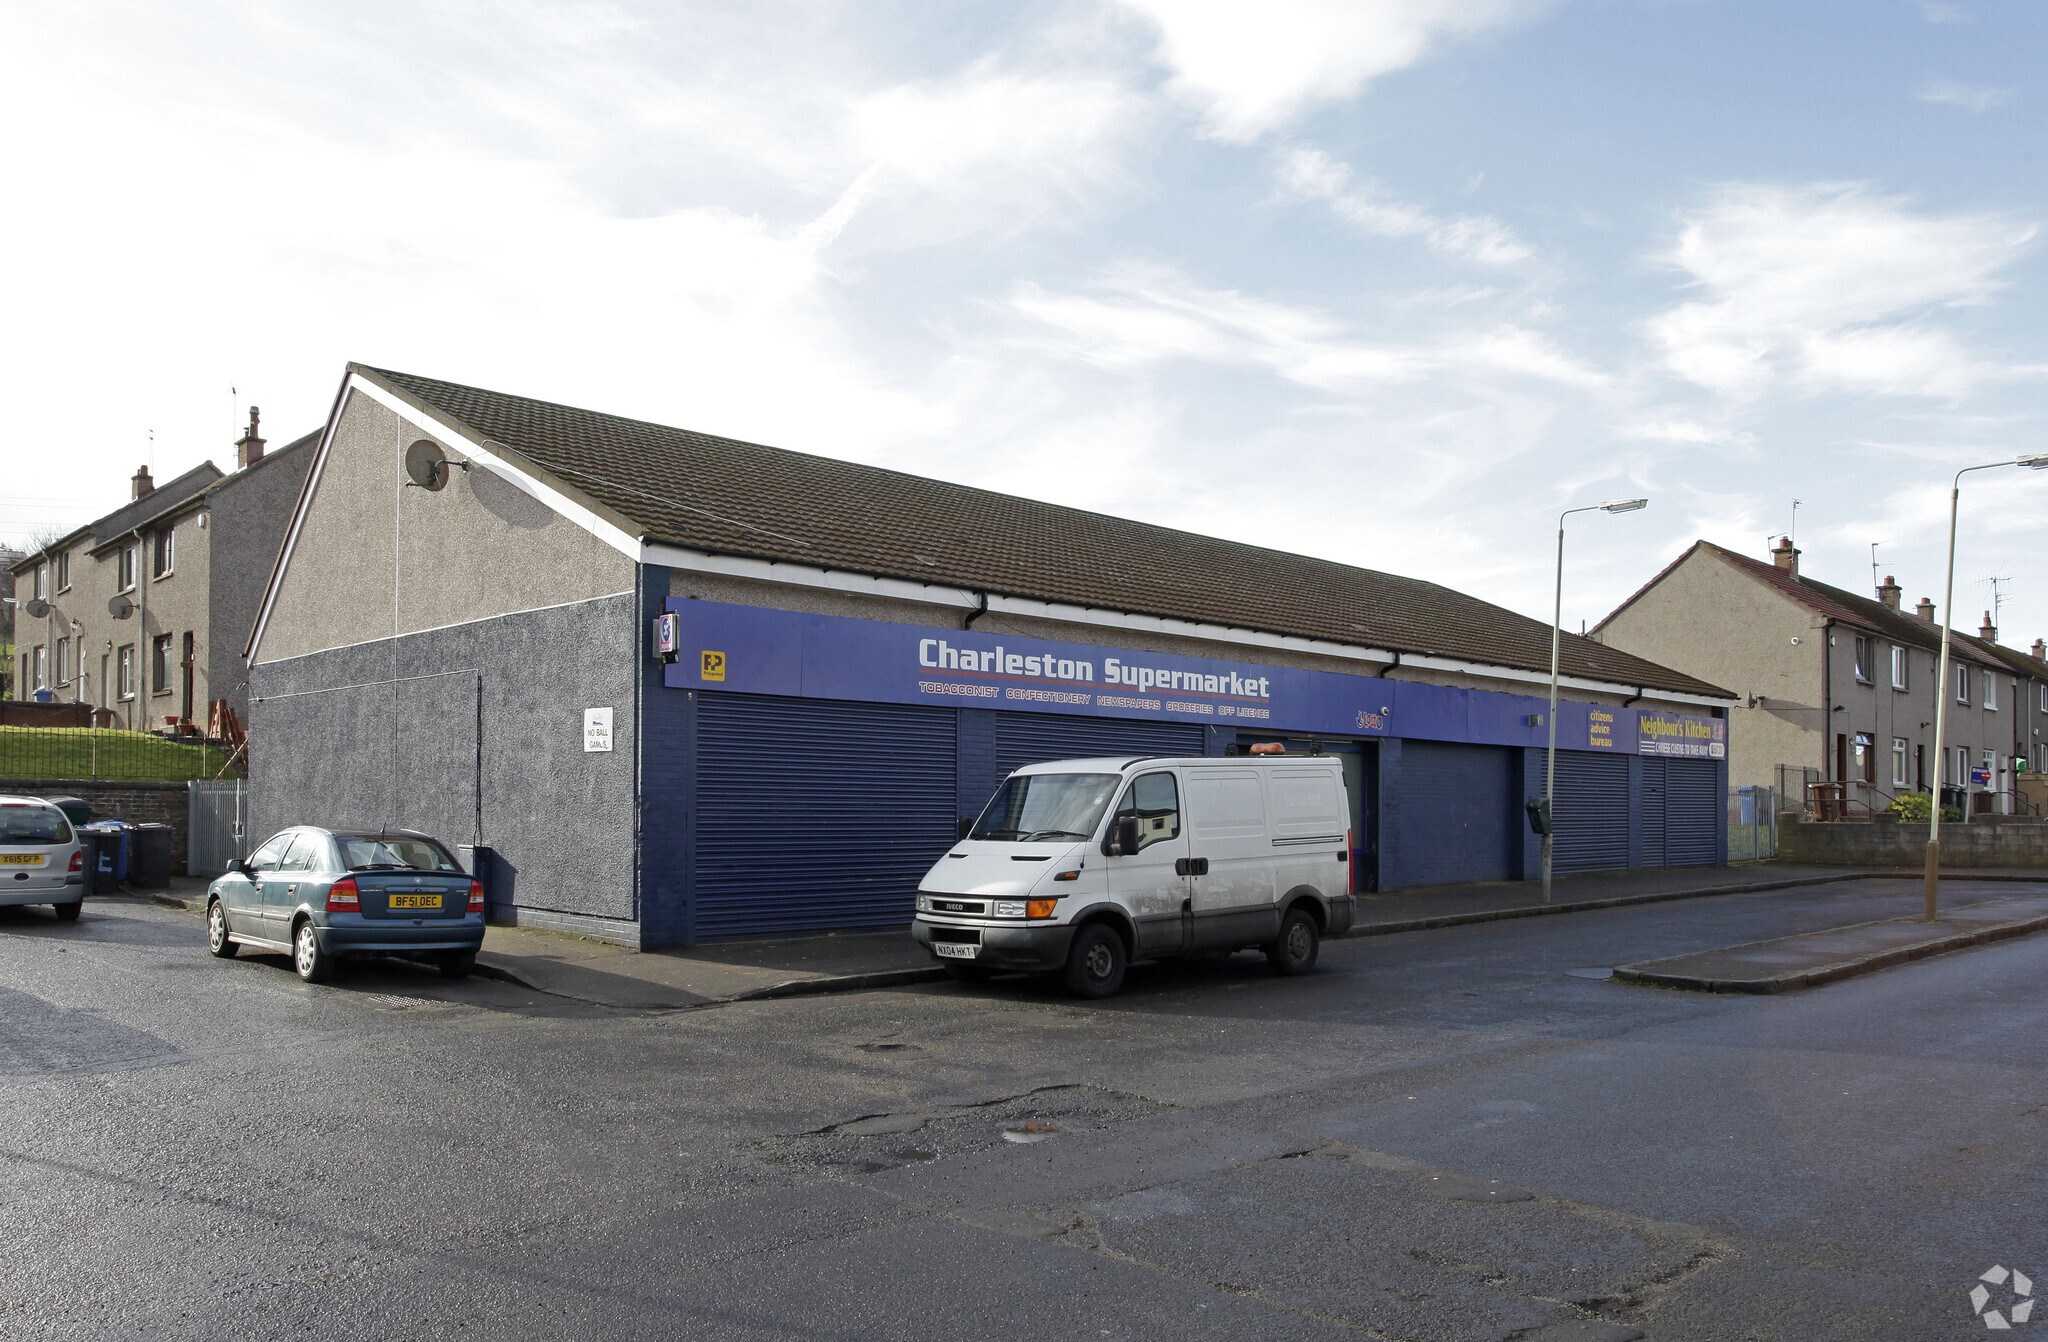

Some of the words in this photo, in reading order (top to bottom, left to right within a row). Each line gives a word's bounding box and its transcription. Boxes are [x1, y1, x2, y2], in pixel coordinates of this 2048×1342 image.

[919, 638, 1093, 681] Charleston
[1104, 657, 1270, 698] Supermarket
[919, 681, 999, 698] TOBACCONIST
[1006, 687, 1091, 705] CONFECTIONERY
[1097, 695, 1161, 711] NEWSPAPERS
[1166, 701, 1213, 714] GROCERIES
[1218, 706, 1235, 716] OFF
[1236, 707, 1270, 719] LICENCE
[1590, 710, 1613, 722] citizens
[587, 729, 595, 737] NO
[1590, 723, 1611, 734] advice
[1640, 715, 1683, 739] Neighbour's
[1685, 720, 1711, 739] Kitchen
[1590, 735, 1613, 747] bureau
[3, 855, 21, 863] X615
[23, 855, 39, 863] GFP
[395, 896, 418, 907] BF51
[937, 945, 955, 955] NX04
[956, 947, 971, 957] HKT
